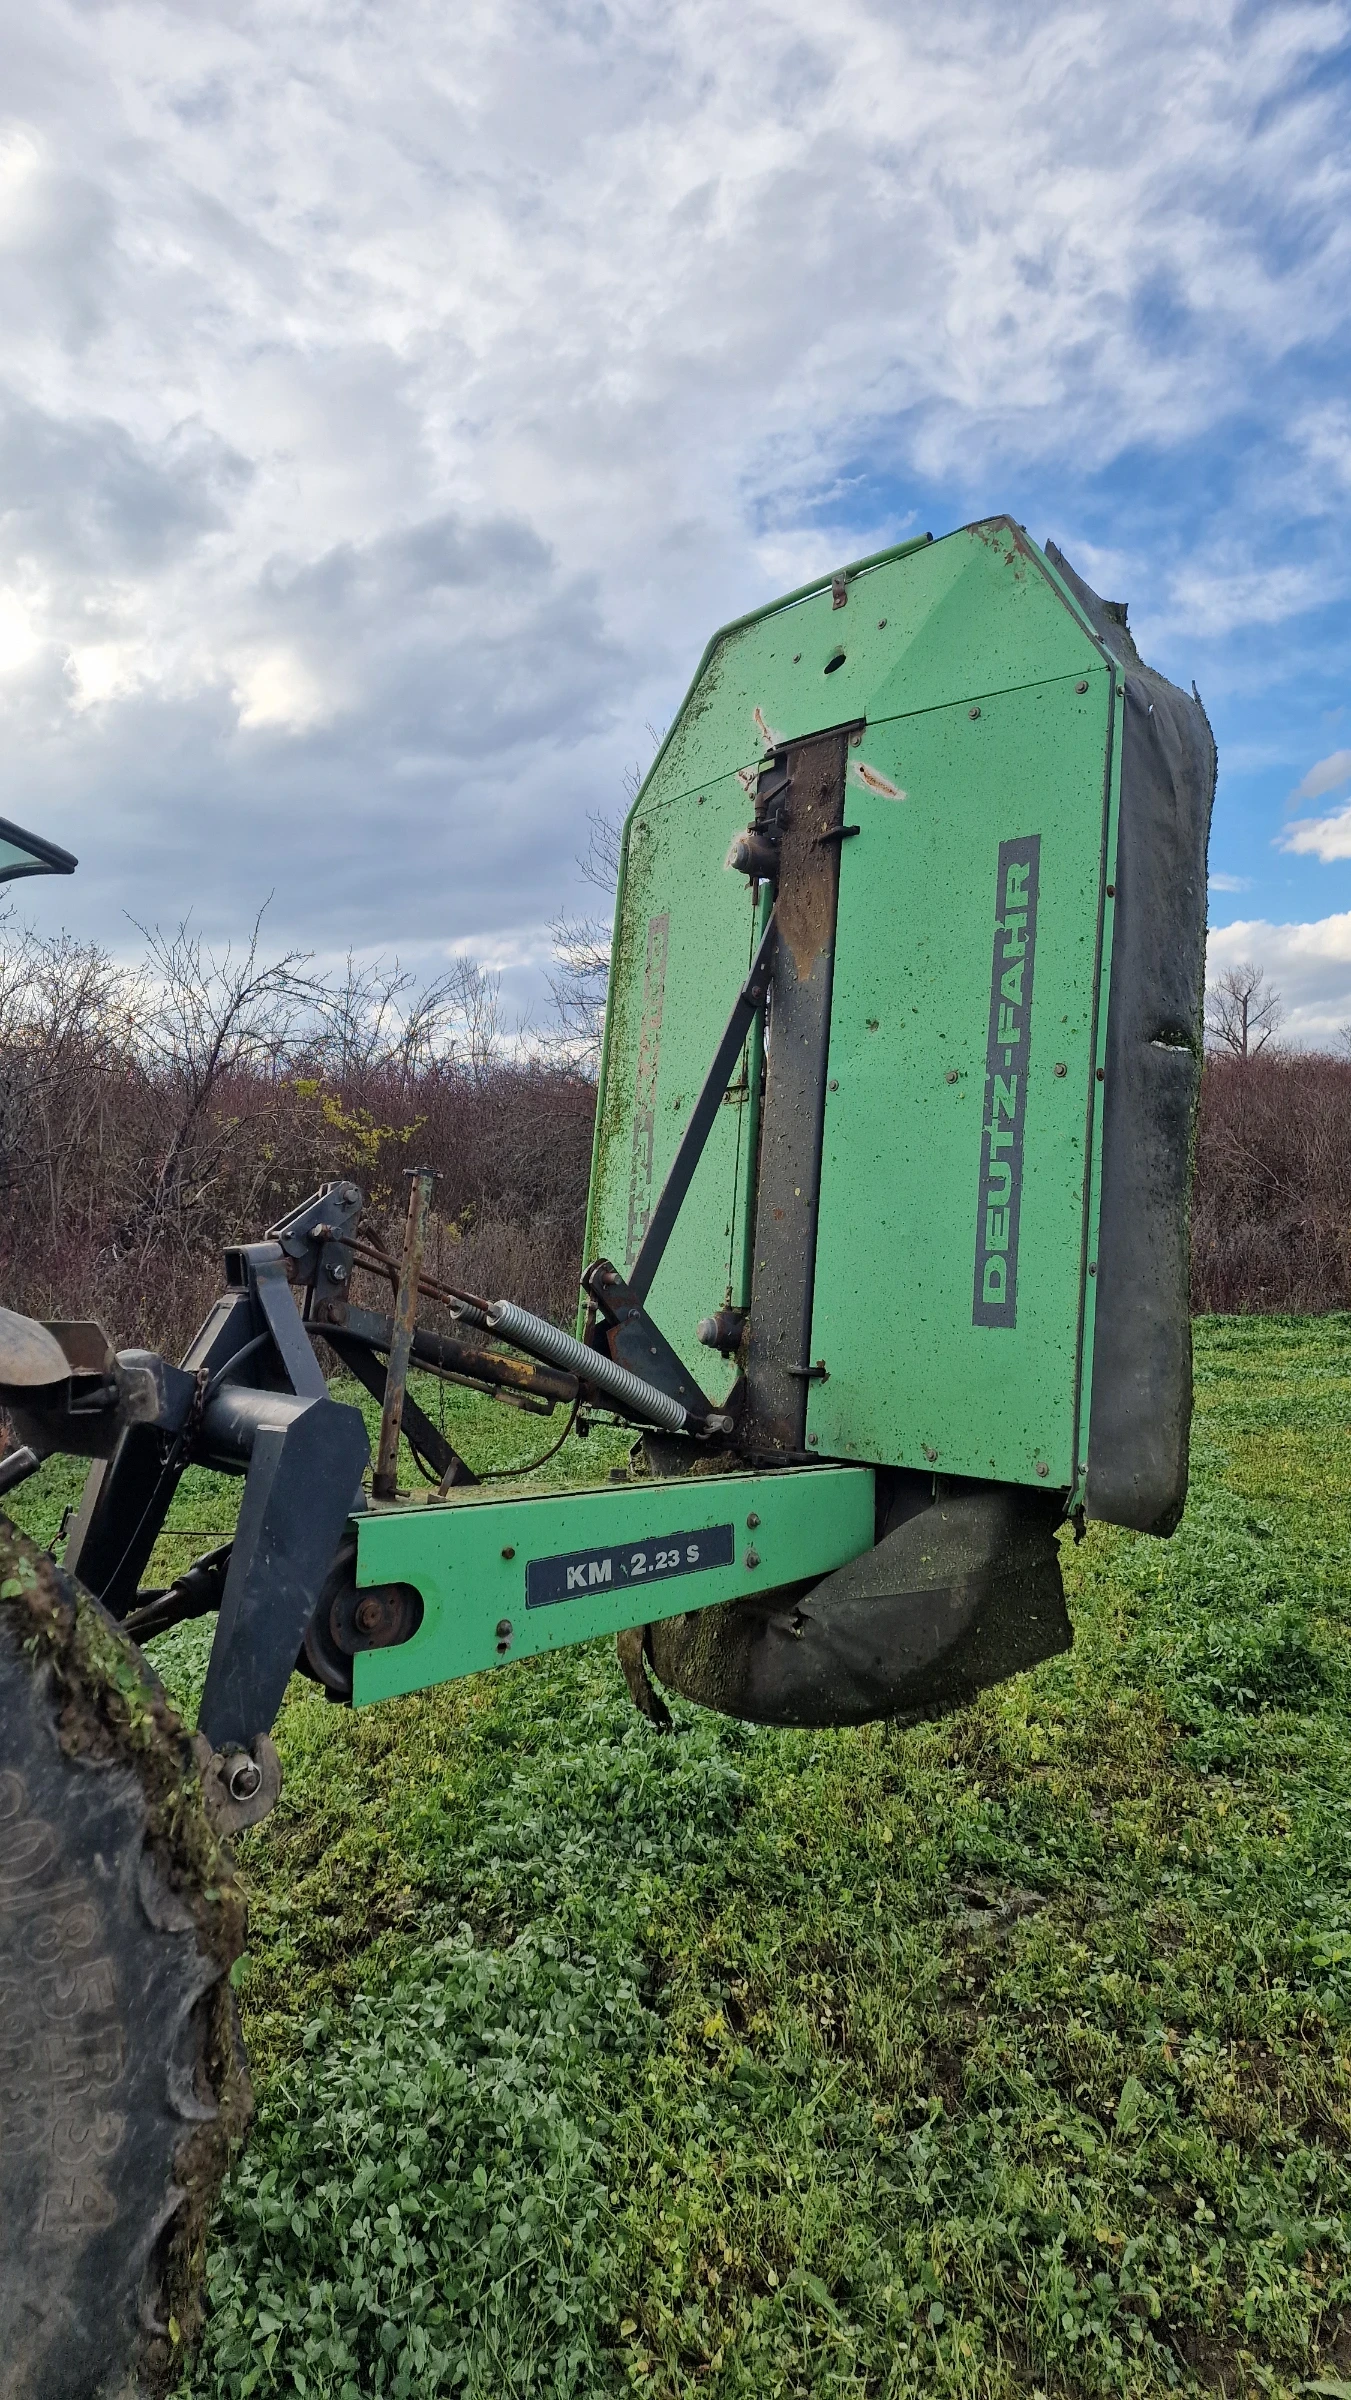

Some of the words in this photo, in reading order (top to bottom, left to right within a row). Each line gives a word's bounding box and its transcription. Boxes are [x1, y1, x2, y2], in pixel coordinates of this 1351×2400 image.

[982, 861, 1030, 1304] DEUTZ-FAHR
[566, 1558, 612, 1590] KM
[630, 1549, 680, 1576] 2.23
[686, 1544, 700, 1563] S
